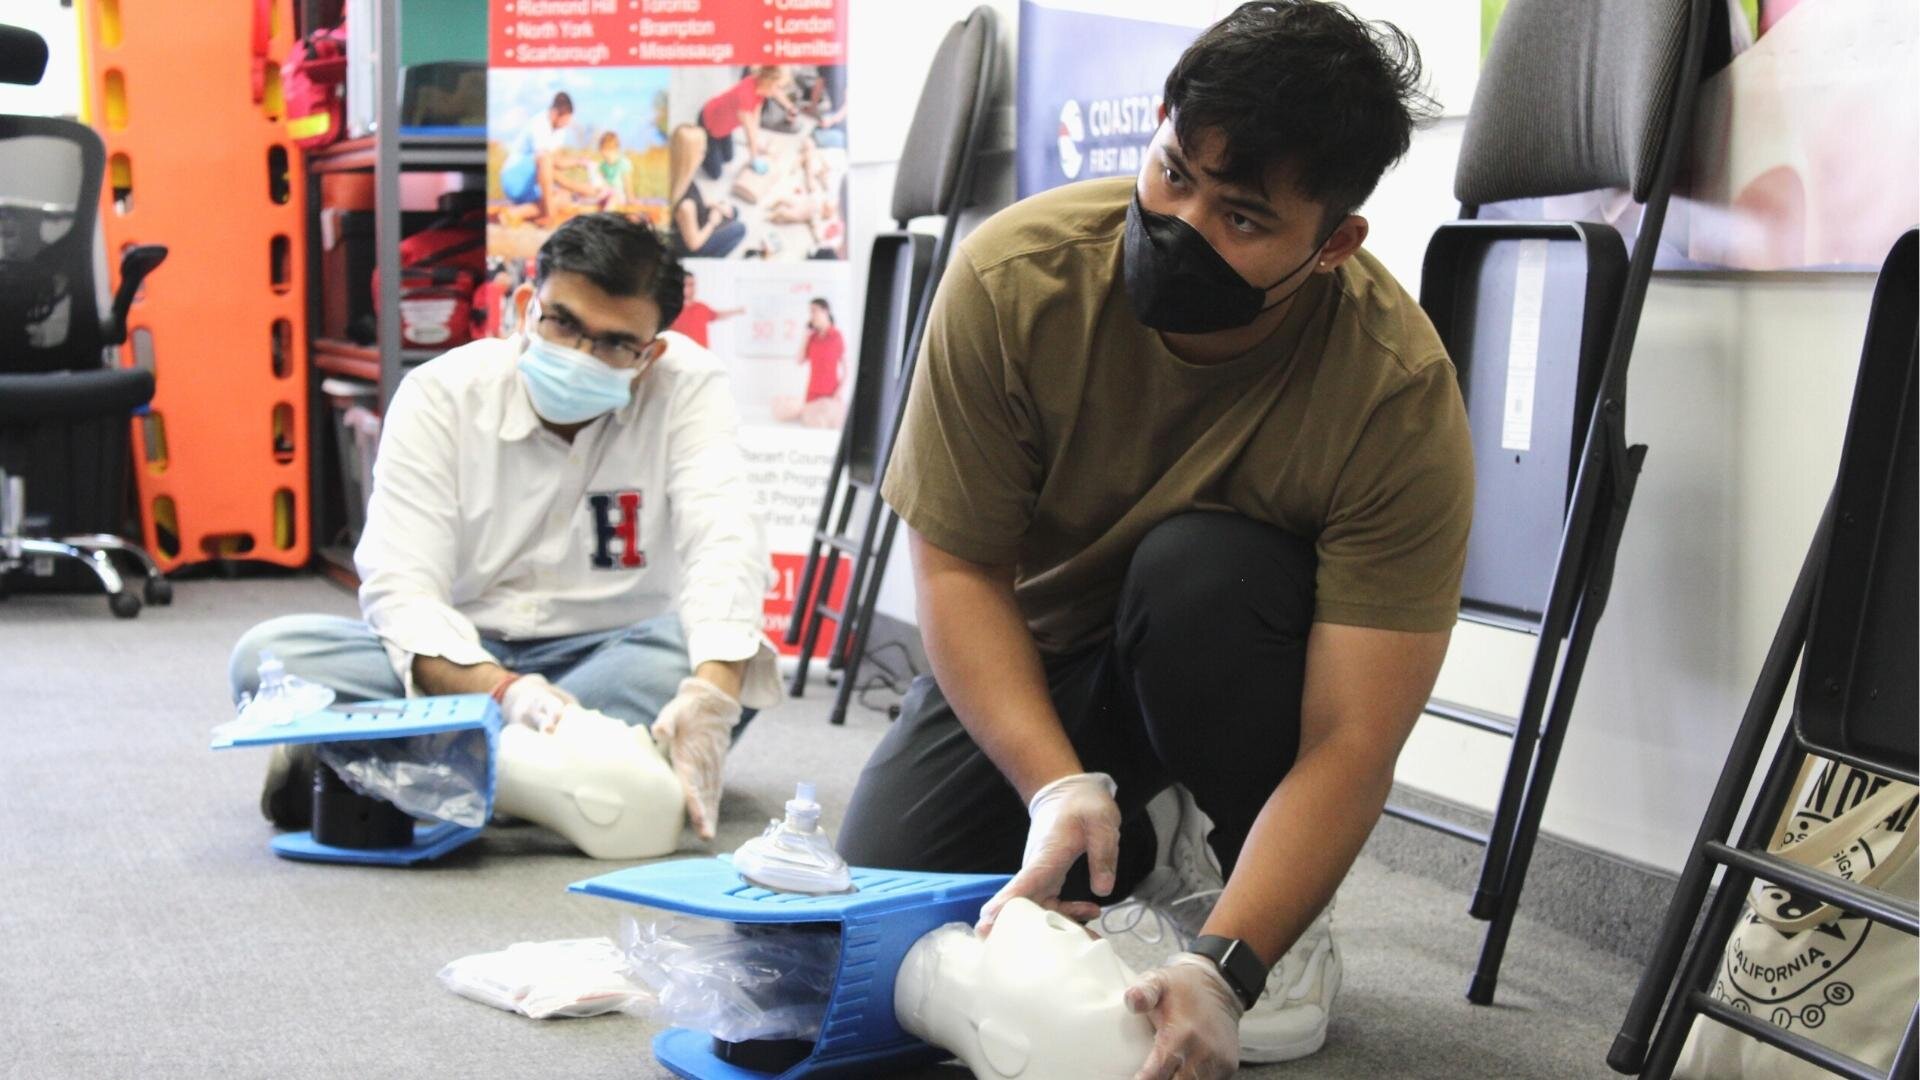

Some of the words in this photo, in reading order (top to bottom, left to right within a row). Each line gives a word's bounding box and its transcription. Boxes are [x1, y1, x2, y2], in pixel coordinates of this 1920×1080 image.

[516, 21, 558, 39] North
[559, 20, 594, 38] York
[640, 17, 715, 38] Brampton
[774, 15, 835, 34] London
[516, 43, 610, 64] Scarborough
[640, 41, 734, 62] Mississauga
[1089, 95, 1163, 137] COAST2C
[1089, 148, 1118, 172] FIRST
[586, 491, 645, 569] H
[764, 569, 794, 601] 21
[1733, 937, 1825, 983] CALIFORNIA
